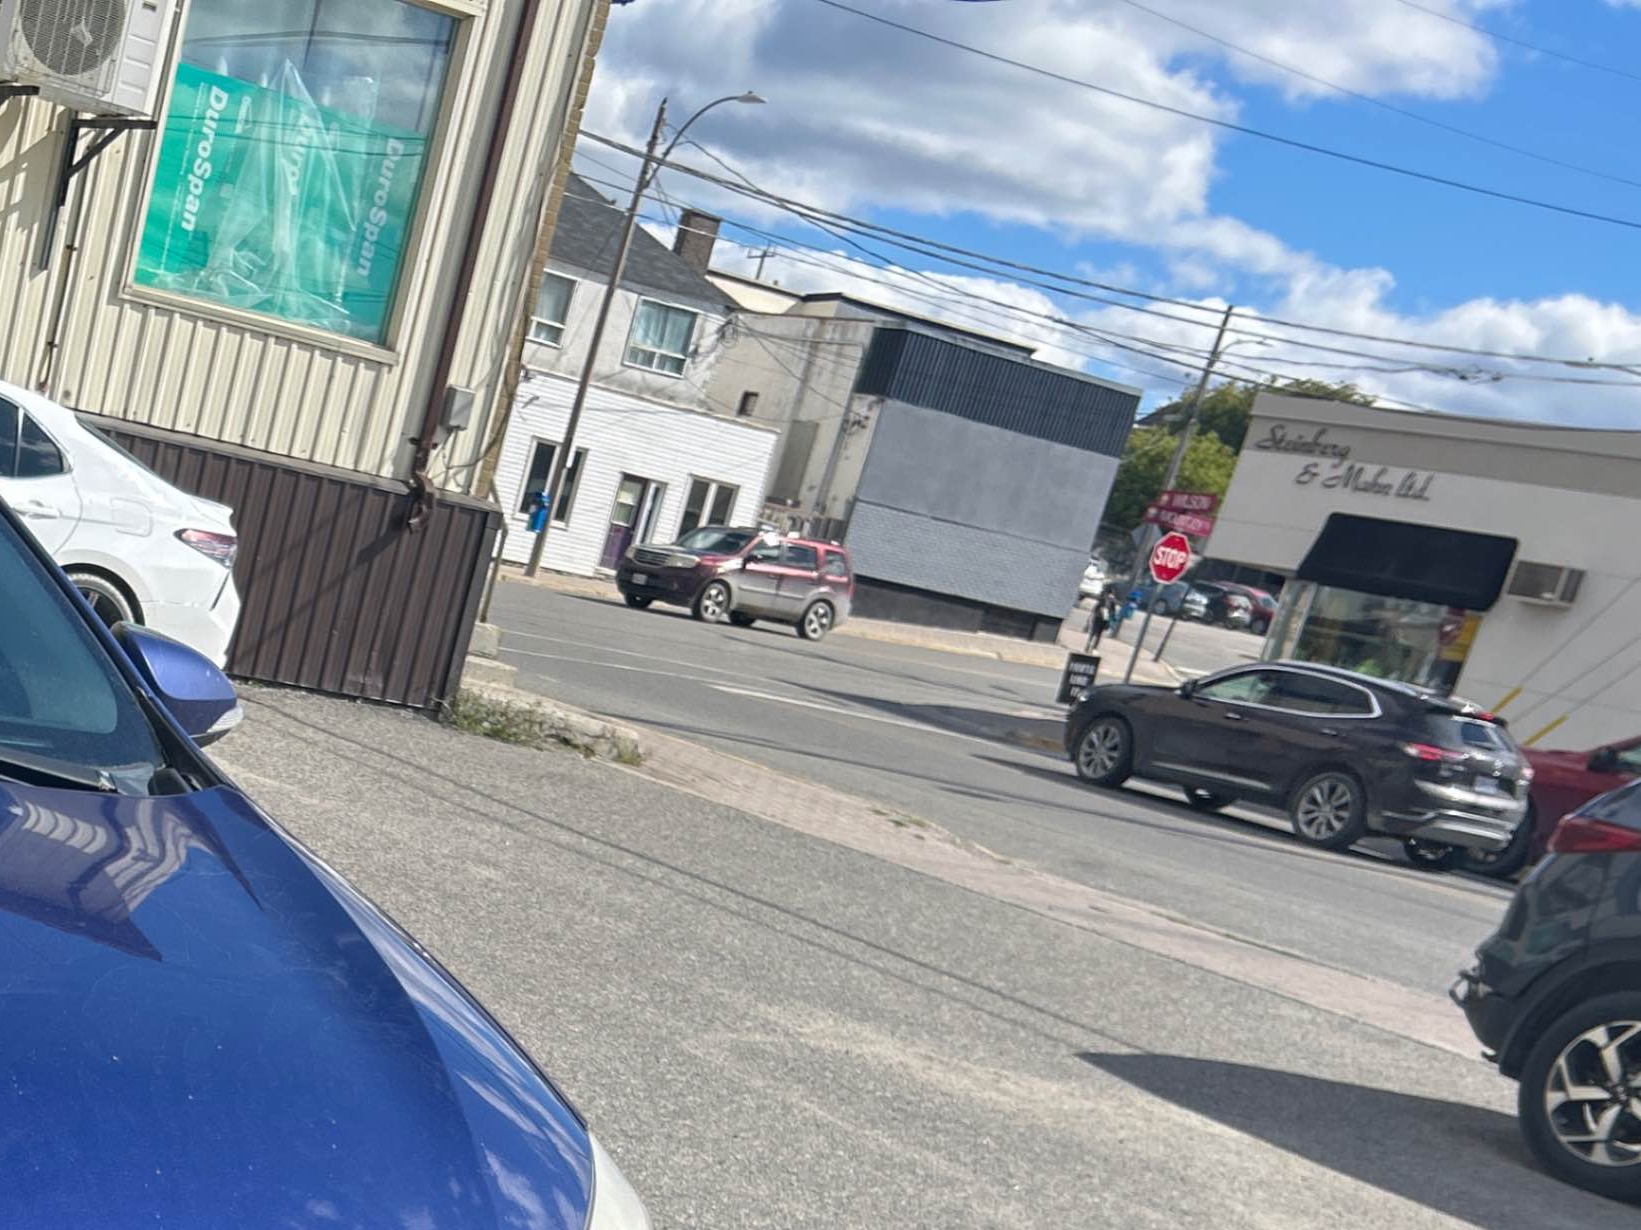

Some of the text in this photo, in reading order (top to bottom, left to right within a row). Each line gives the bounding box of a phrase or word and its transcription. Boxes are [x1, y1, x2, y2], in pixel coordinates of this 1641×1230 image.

[181, 85, 229, 232] DuroSpan
[357, 137, 405, 278] DuroSpan
[1294, 462, 1320, 485] &
[1154, 546, 1187, 570] STOP
